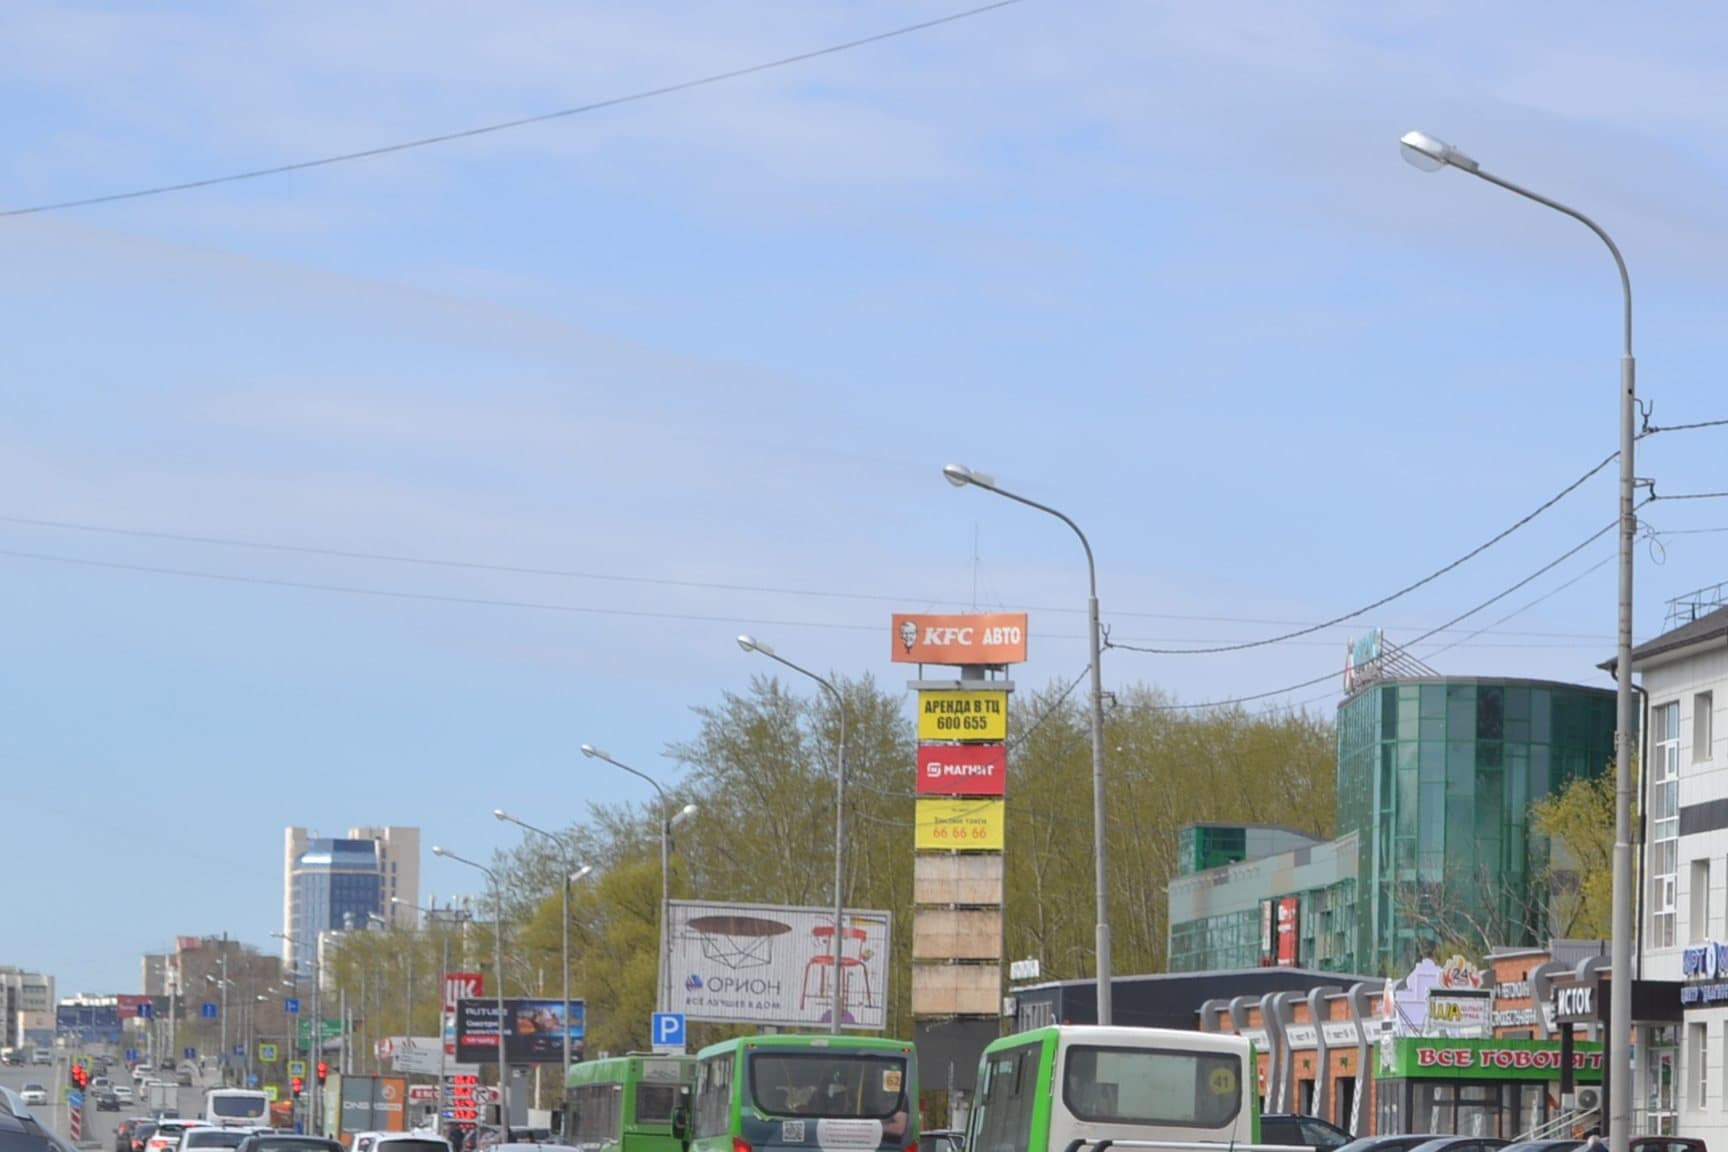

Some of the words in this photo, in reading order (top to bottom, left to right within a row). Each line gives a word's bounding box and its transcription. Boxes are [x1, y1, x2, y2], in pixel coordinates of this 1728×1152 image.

[922, 626, 974, 646] KFC
[982, 626, 1021, 645] АВТО
[924, 700, 971, 714] АРЕНДА
[973, 700, 983, 713] В
[985, 700, 1000, 714] ТЦ
[937, 716, 960, 730] 600
[963, 716, 987, 730] 655
[943, 765, 994, 776] МАГНИТ
[1453, 968, 1468, 980] 24
[707, 977, 780, 996] ОРИОН
[1558, 986, 1592, 1016] ИСТОК
[661, 1016, 680, 1042] P
[1417, 1047, 1473, 1067] ВСЕ
[1213, 1074, 1230, 1083] 41
